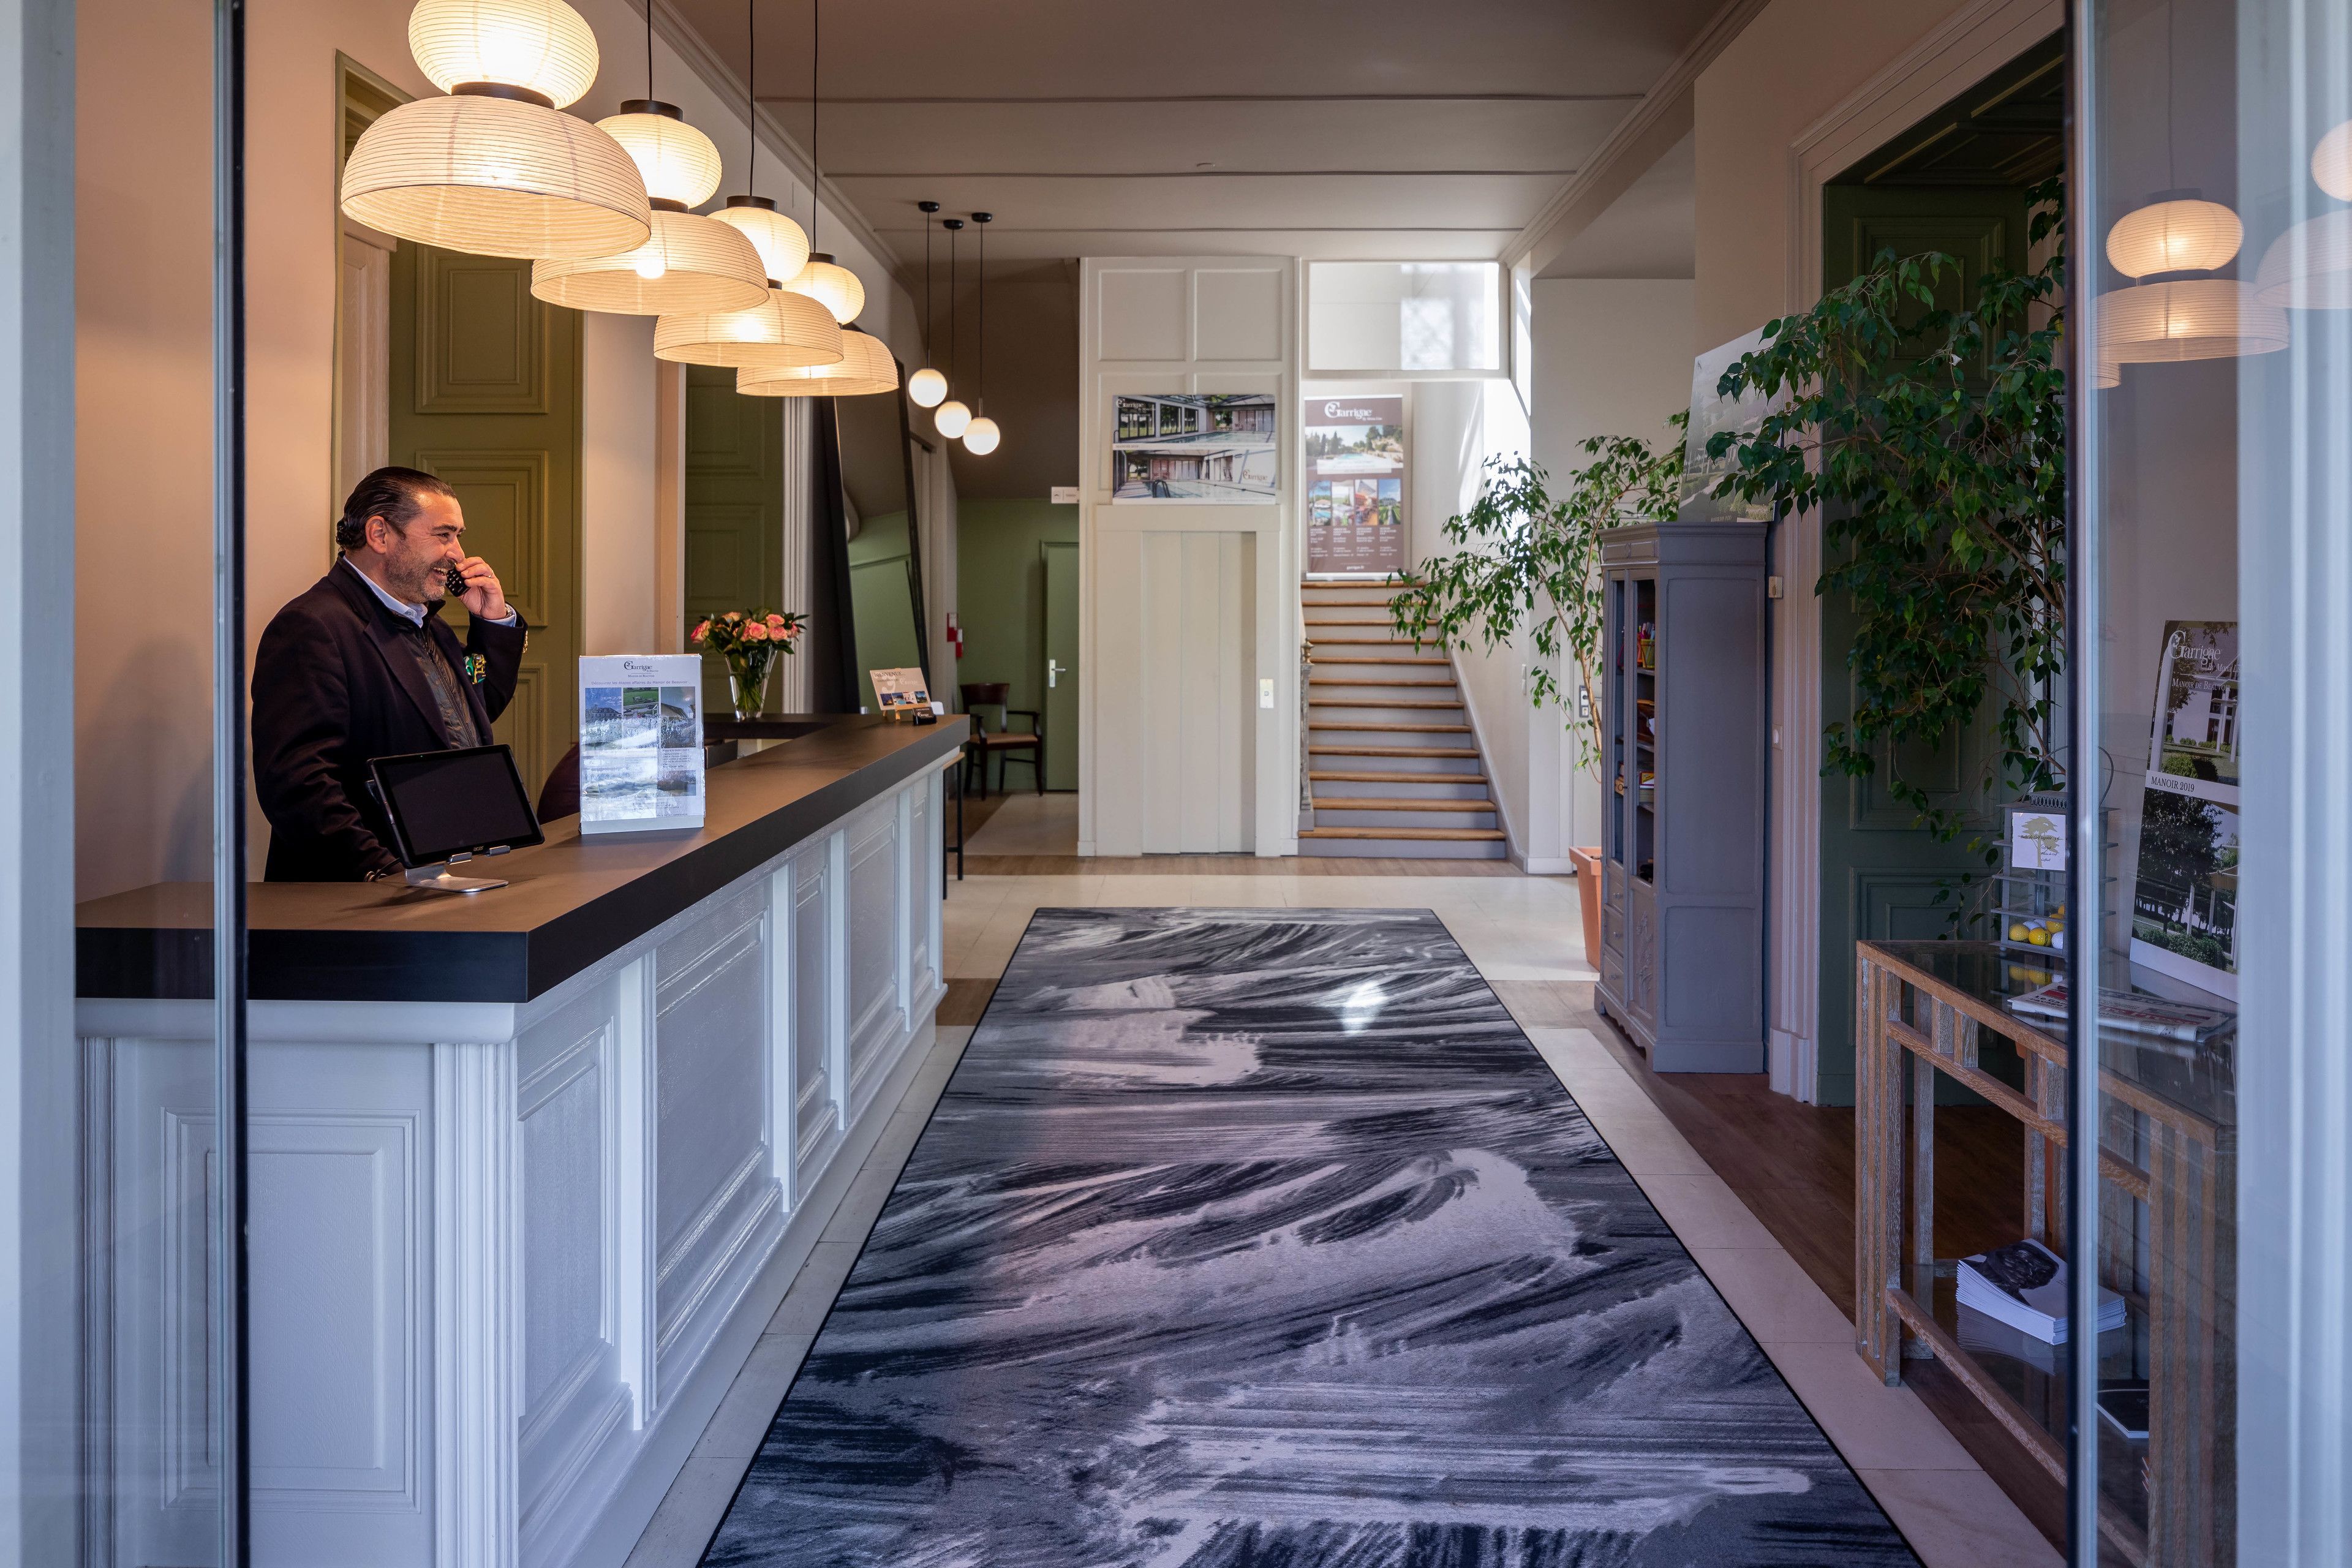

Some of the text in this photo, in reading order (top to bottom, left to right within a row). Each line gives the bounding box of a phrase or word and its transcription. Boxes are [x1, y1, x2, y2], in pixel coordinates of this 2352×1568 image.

[1324, 402, 1372, 420] Garrigae
[2169, 630, 2221, 665] Garrigae
[624, 660, 652, 671] Garrigae
[2207, 663, 2215, 674] By
[2216, 663, 2232, 673] Mona
[2171, 678, 2195, 688] MANOIR
[2204, 680, 2231, 692] BEAUVOIR
[2150, 775, 2195, 793] MANOIR 2019
